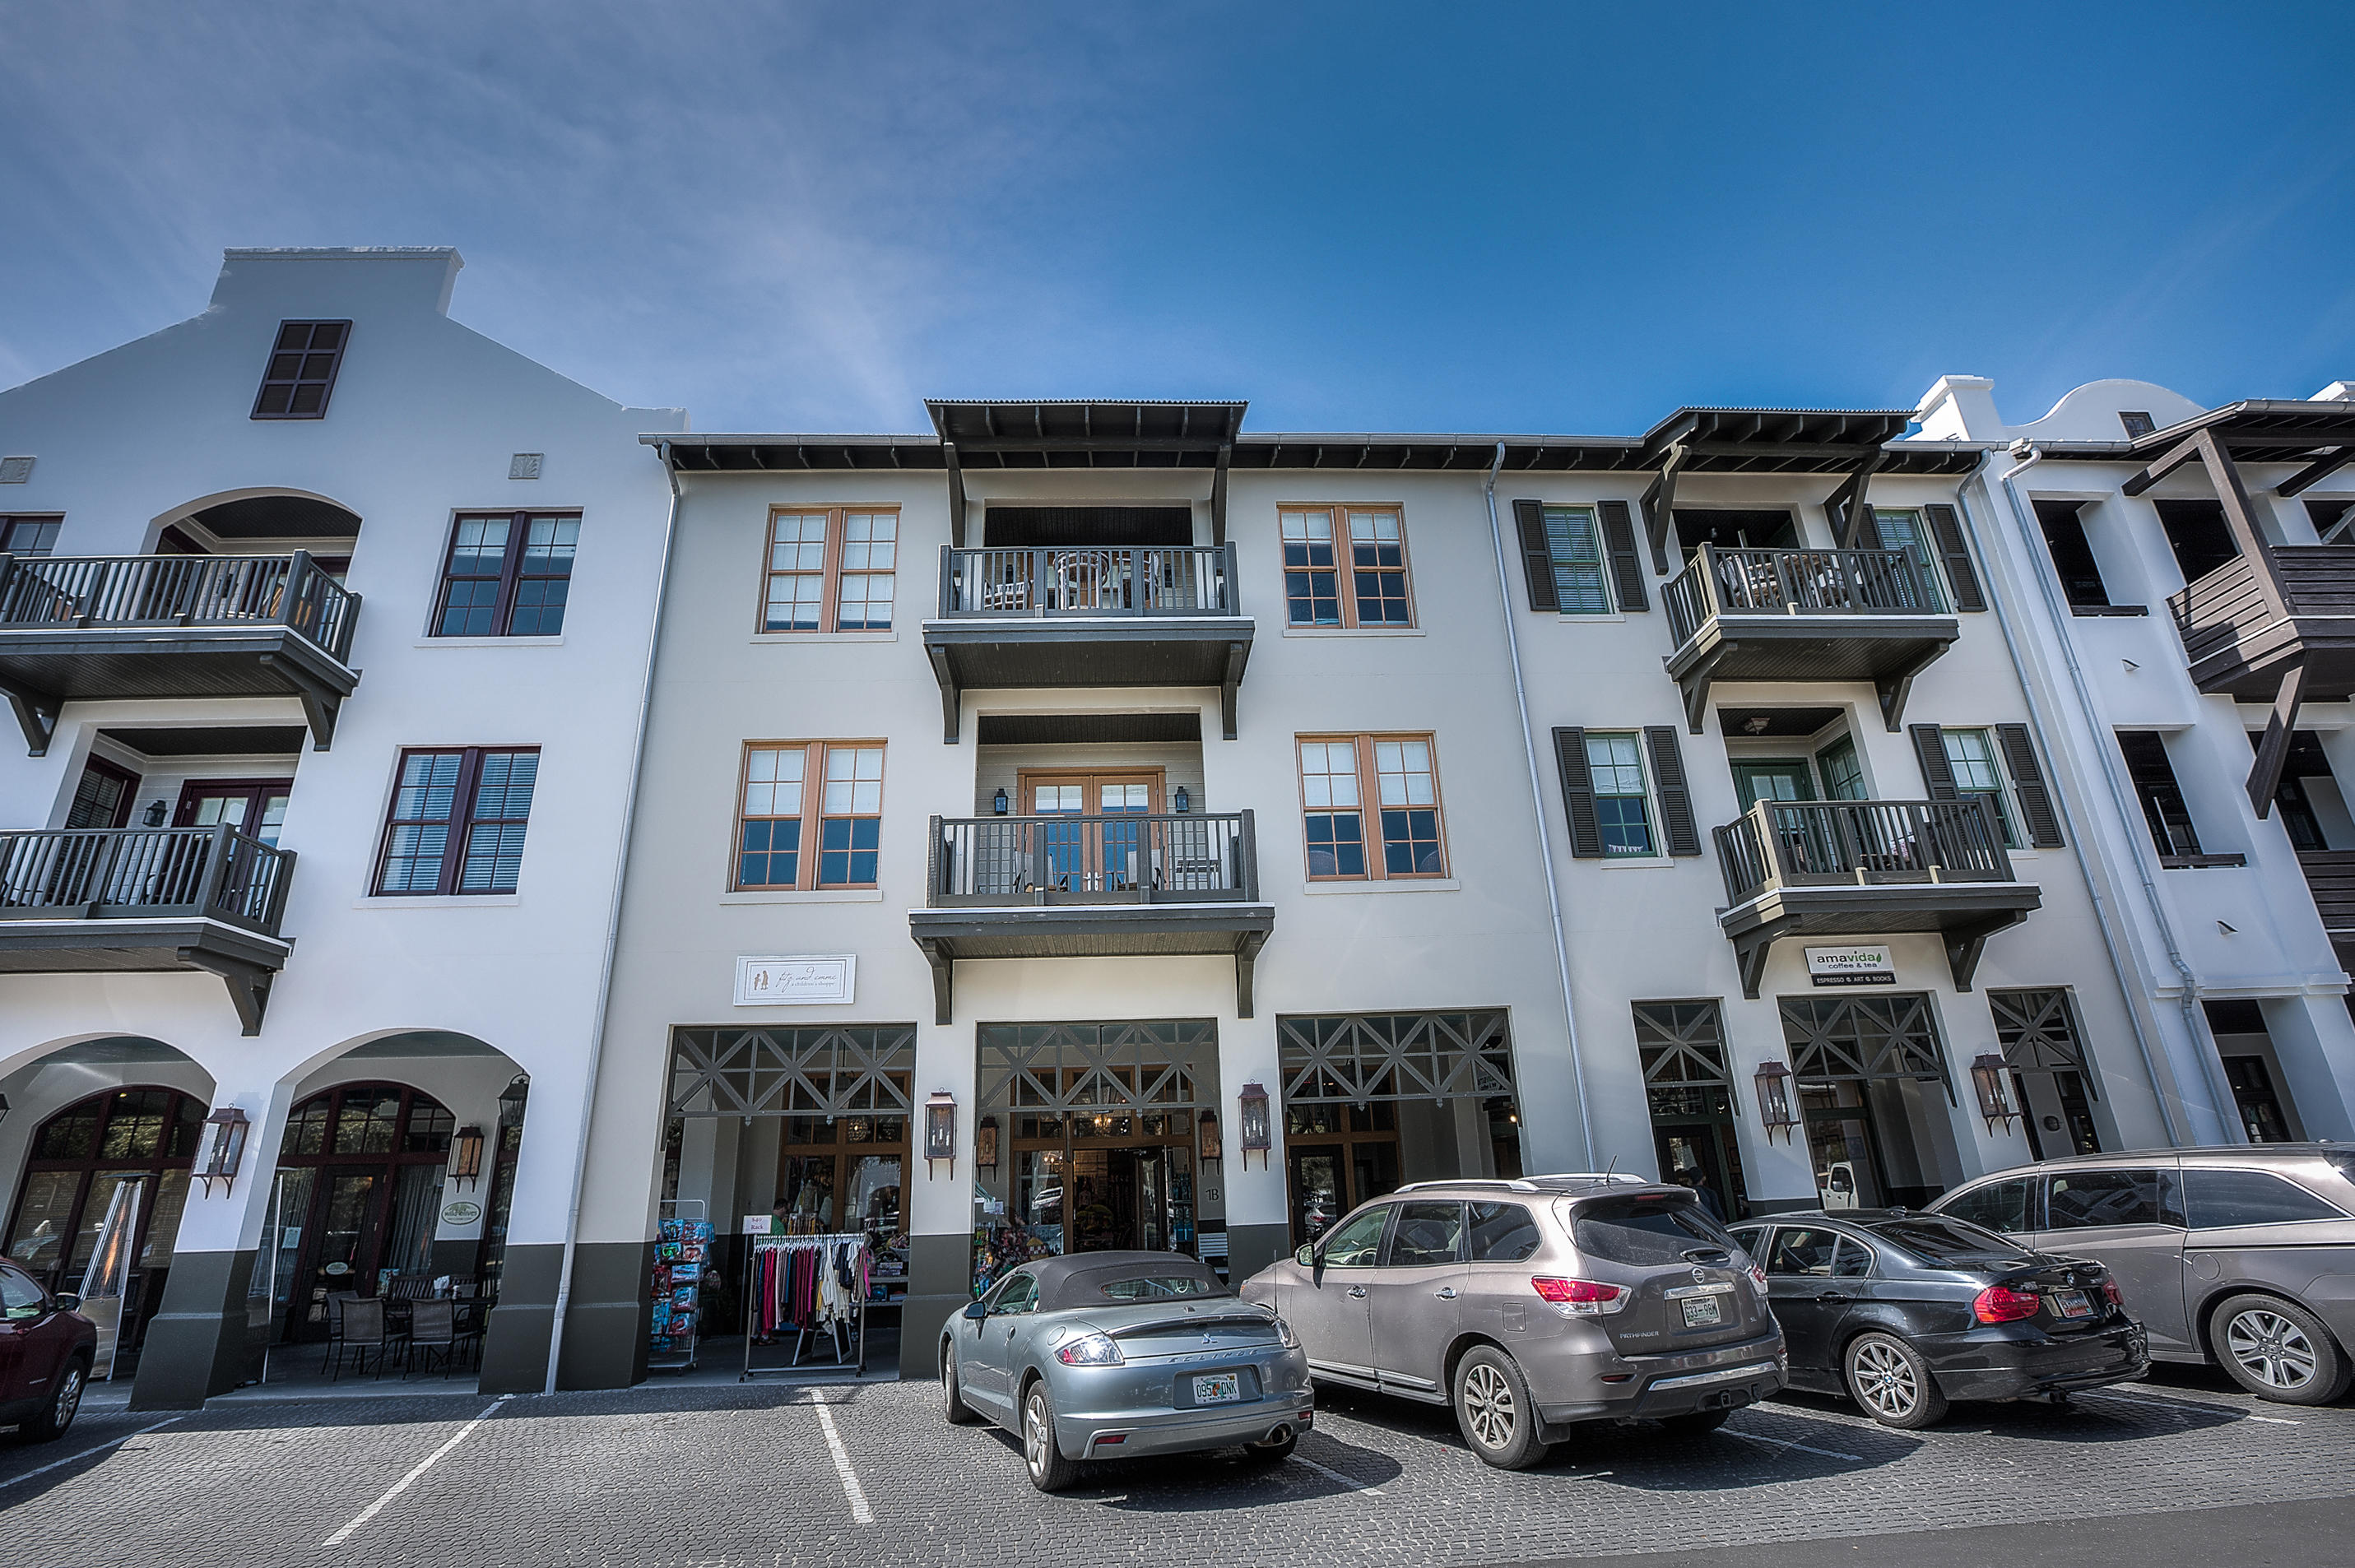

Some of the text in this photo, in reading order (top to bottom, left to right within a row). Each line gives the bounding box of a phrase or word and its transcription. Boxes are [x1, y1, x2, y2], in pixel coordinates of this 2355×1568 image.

[1817, 951, 1876, 963] amavida
[1205, 1189, 1219, 1201] 1B
[1168, 1349, 1258, 1363] ECLIPSE
